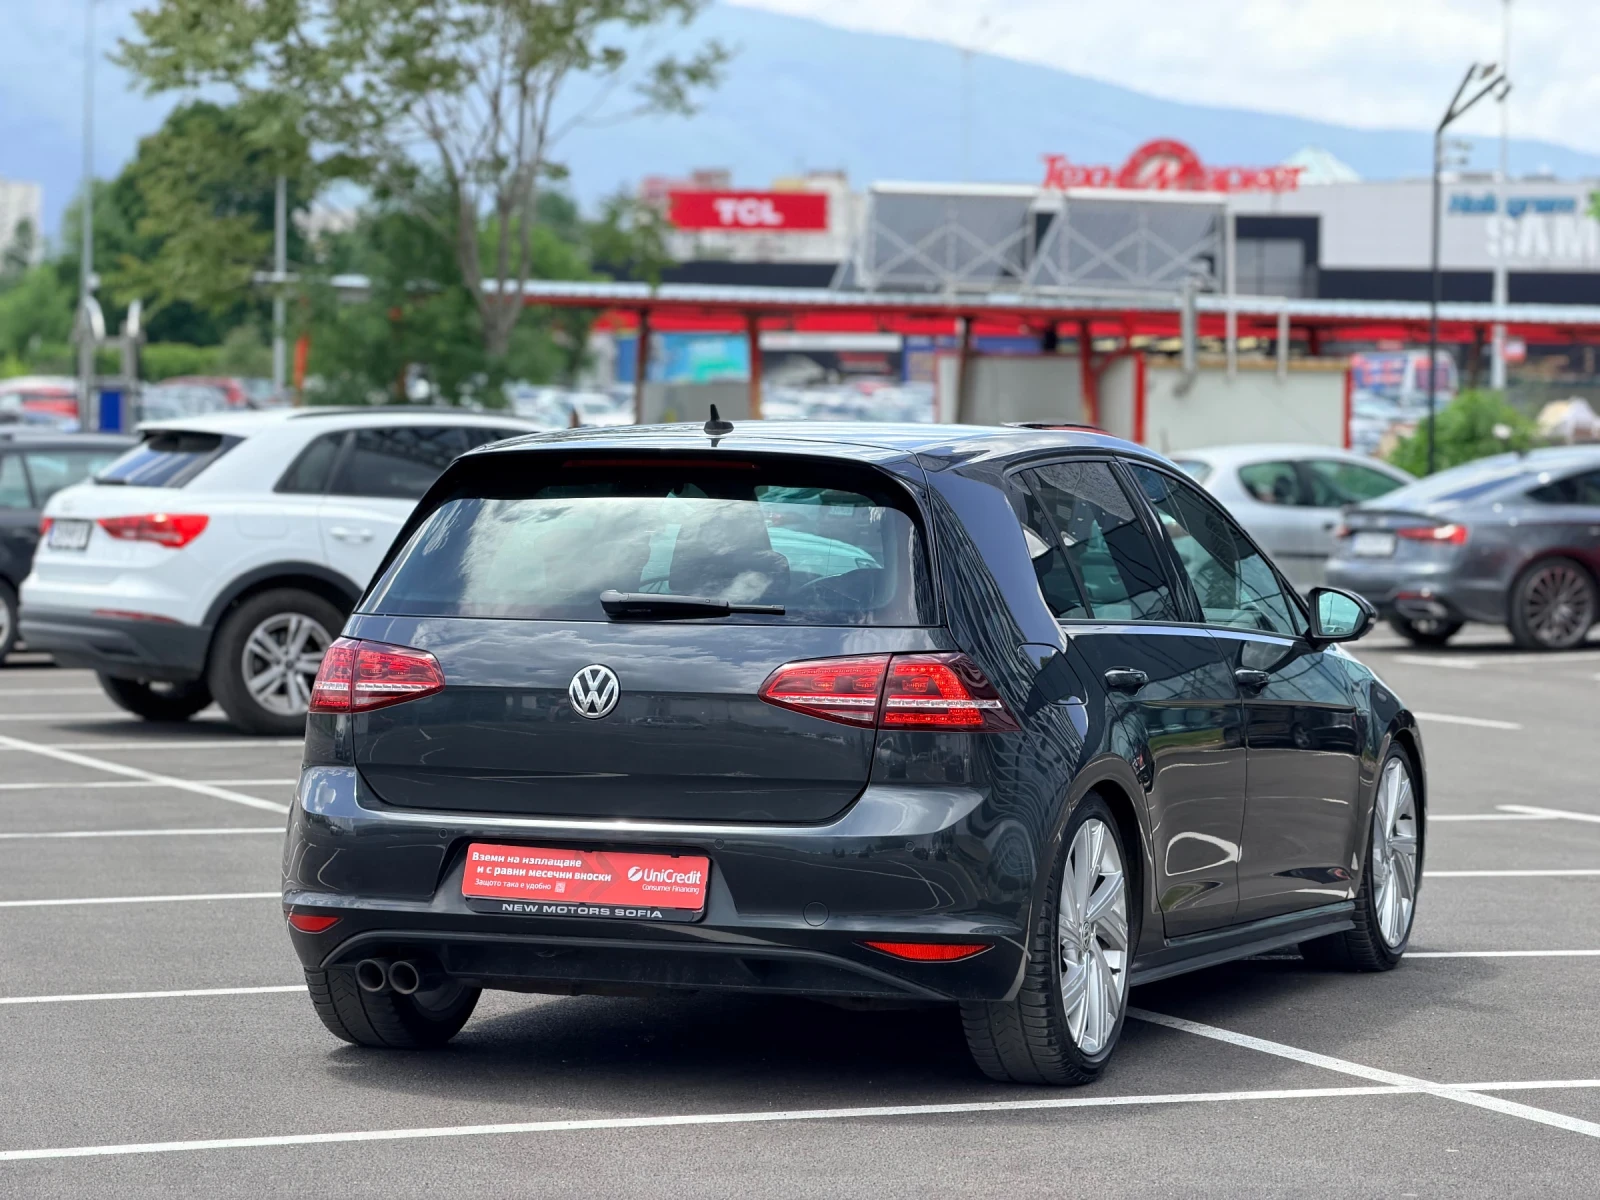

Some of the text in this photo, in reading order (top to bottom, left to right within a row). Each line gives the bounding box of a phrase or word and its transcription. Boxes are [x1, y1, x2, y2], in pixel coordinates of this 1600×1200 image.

[713, 196, 785, 226] TCL
[472, 852, 582, 868] Вземи на изплащане
[494, 868, 526, 876] равни
[528, 870, 572, 880] месечни
[574, 872, 612, 882] вноски
[643, 868, 702, 884] UniCredit
[475, 878, 501, 887] Защото
[503, 880, 519, 888] така
[526, 882, 551, 890] удобно
[642, 884, 700, 894] Consumer Financing
[502, 903, 663, 918] NEW MOTORS SOFIA
